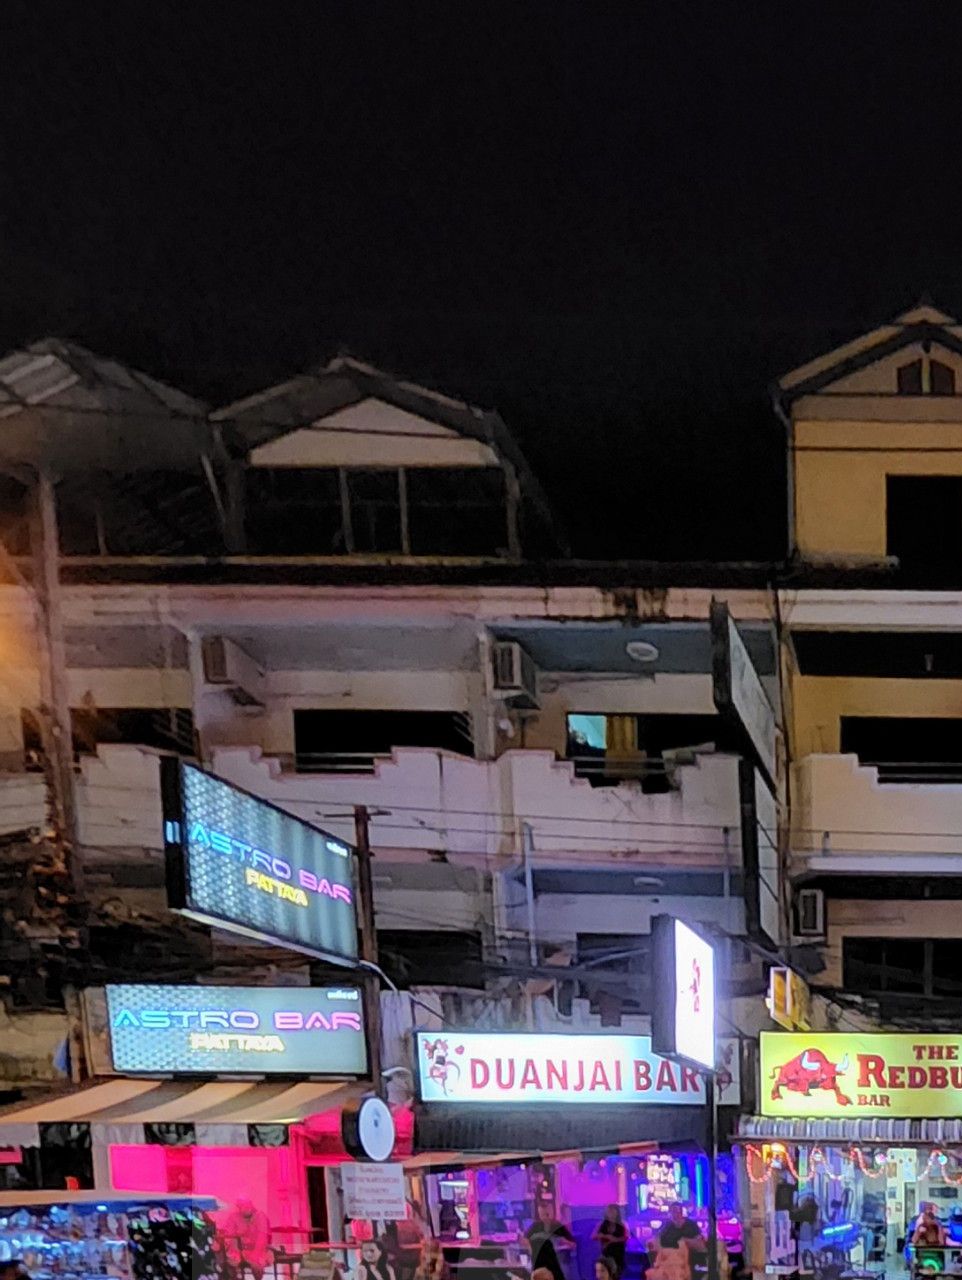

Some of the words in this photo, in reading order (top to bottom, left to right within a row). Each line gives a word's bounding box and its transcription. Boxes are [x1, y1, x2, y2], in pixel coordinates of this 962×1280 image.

[191, 822, 292, 879] ASTRO
[299, 868, 353, 905] BAR
[245, 867, 309, 908] PATTAYA
[111, 1008, 261, 1030] ASTRO
[273, 1009, 362, 1031] BAR
[189, 1032, 286, 1052] PATTAYA
[912, 1044, 960, 1061] THE
[470, 1057, 623, 1092] DUANJAI
[633, 1058, 702, 1093] BAR
[856, 1093, 891, 1108] BAR
